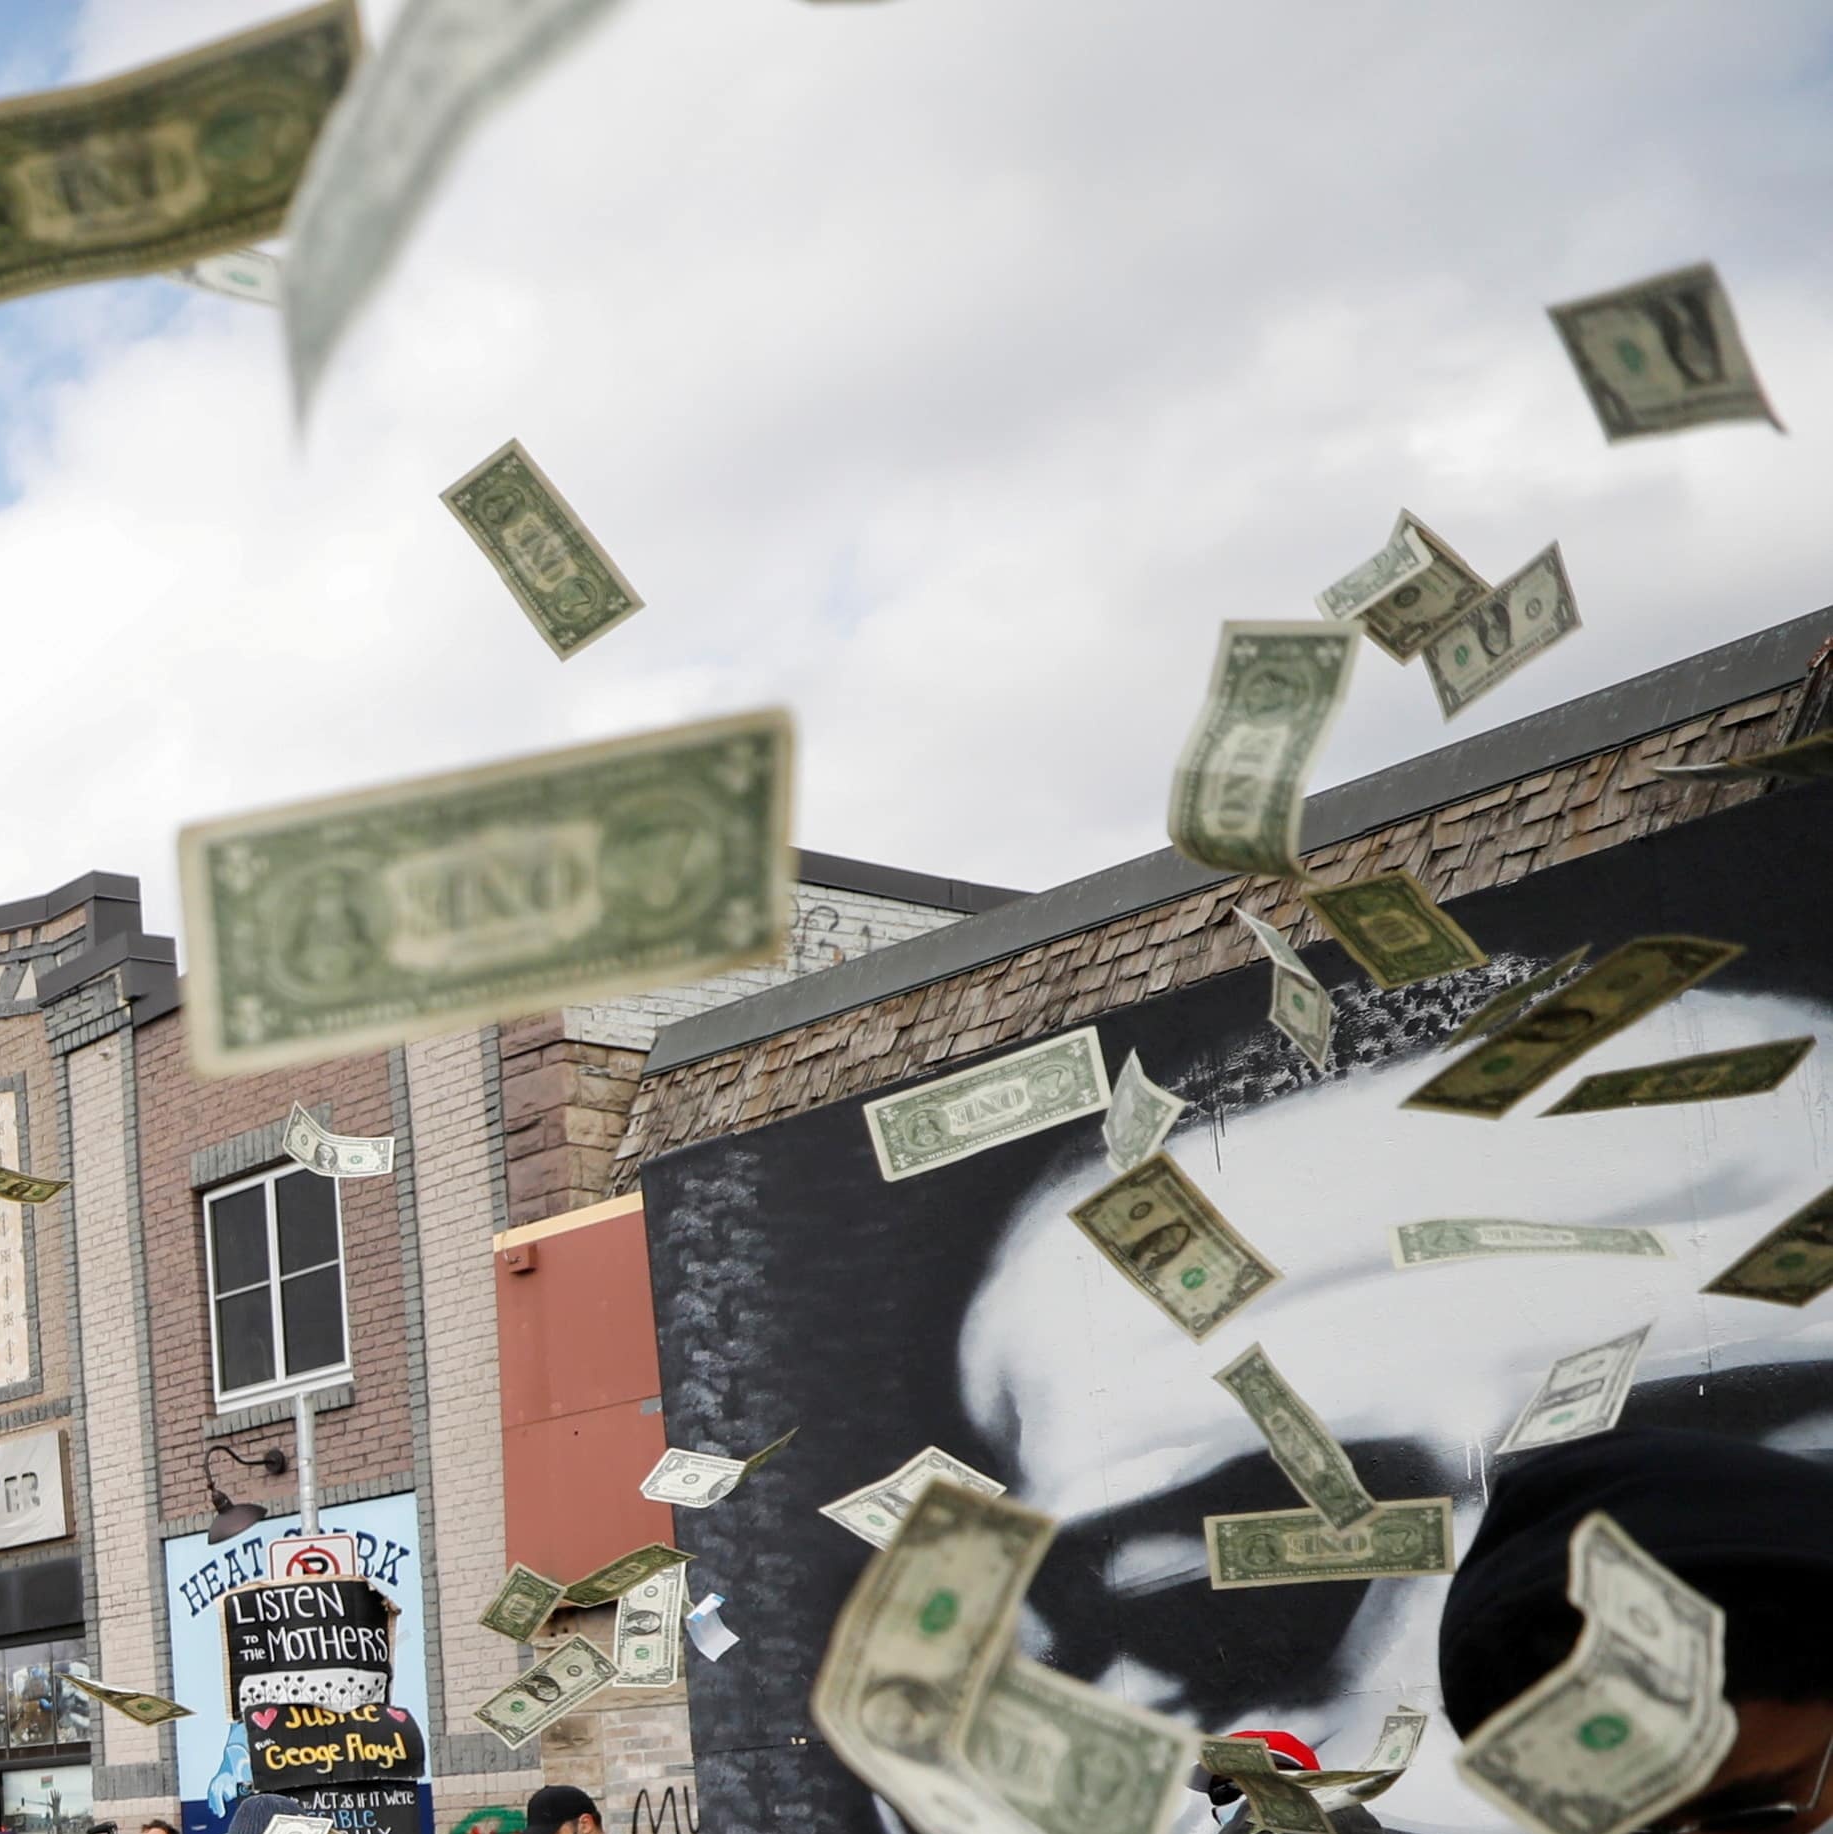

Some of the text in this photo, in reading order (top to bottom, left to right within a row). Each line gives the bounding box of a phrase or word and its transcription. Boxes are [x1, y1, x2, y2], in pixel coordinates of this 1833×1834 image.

[179, 1537, 264, 1617] HEAT
[265, 1732, 407, 1774] Geoge Floyd
[313, 1791, 338, 1810] ACT
